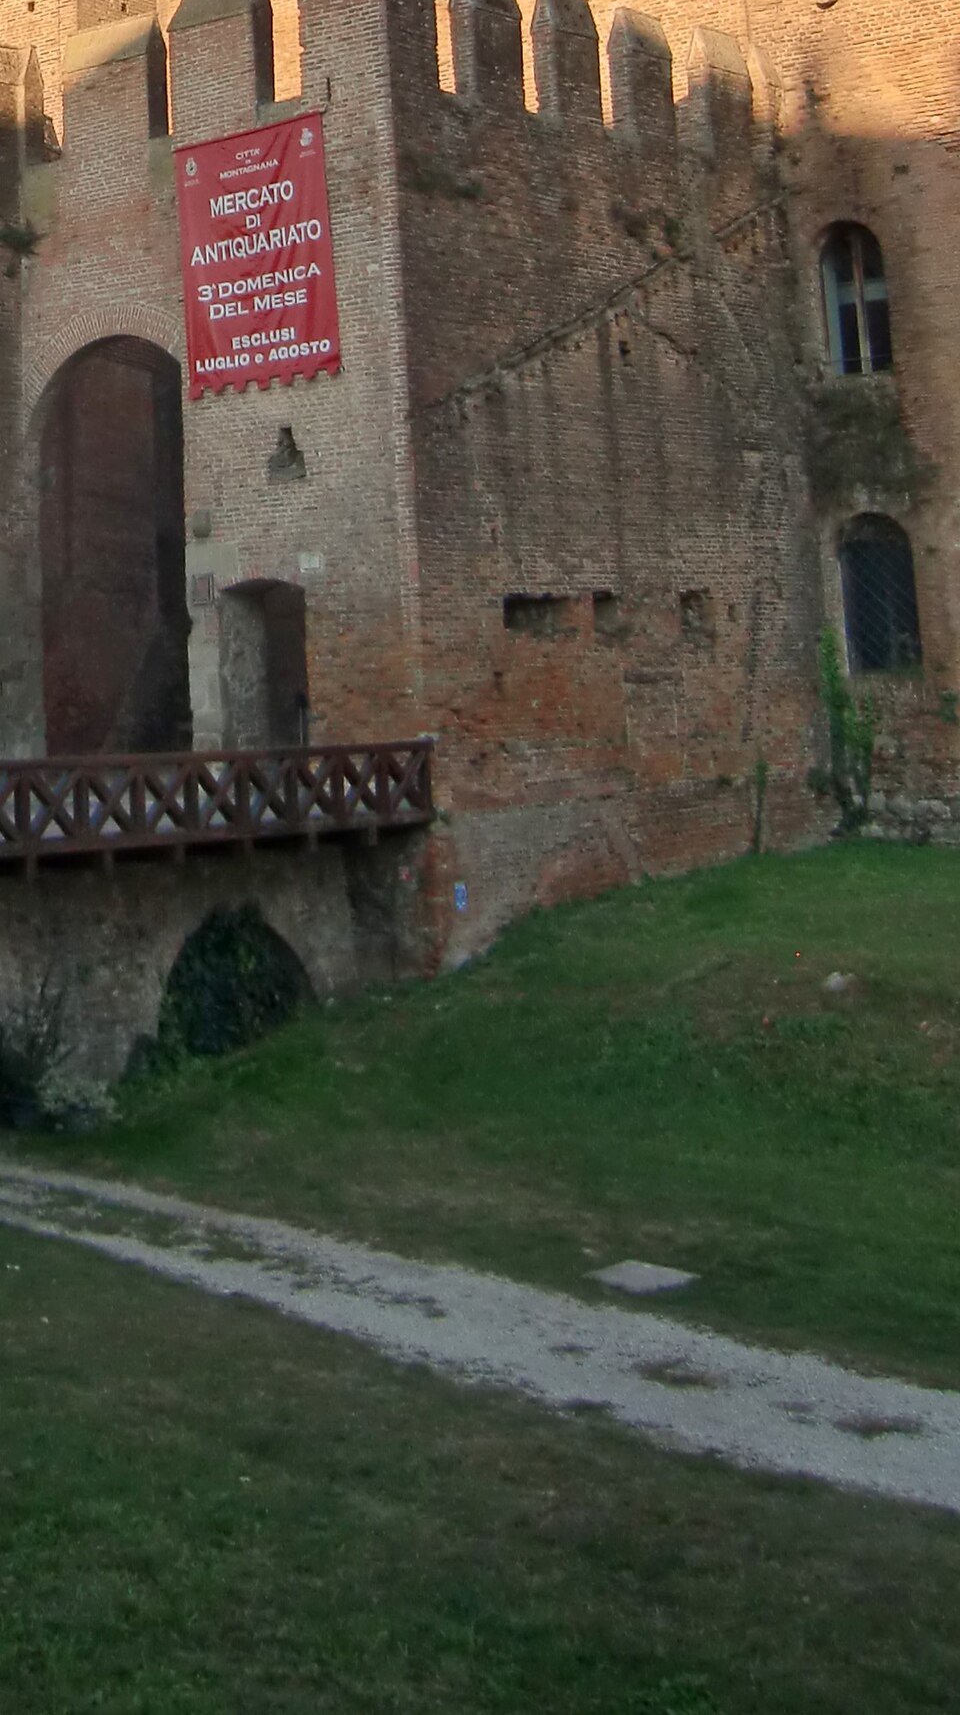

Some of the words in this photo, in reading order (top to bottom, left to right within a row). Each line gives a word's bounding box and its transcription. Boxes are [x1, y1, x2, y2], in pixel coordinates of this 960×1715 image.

[219, 158, 279, 179] MONTAGNANA
[209, 180, 294, 218] MERCATO
[246, 213, 261, 229] DI
[191, 219, 321, 266] ANTIQUARIATO
[218, 262, 321, 299] DOMENICA
[209, 302, 249, 320] DEL
[253, 288, 308, 312] MESE
[232, 327, 296, 350] ESCLUSI
[196, 353, 250, 372] LUGLIO
[254, 354, 264, 364] e
[268, 339, 331, 361] AGOSTO
